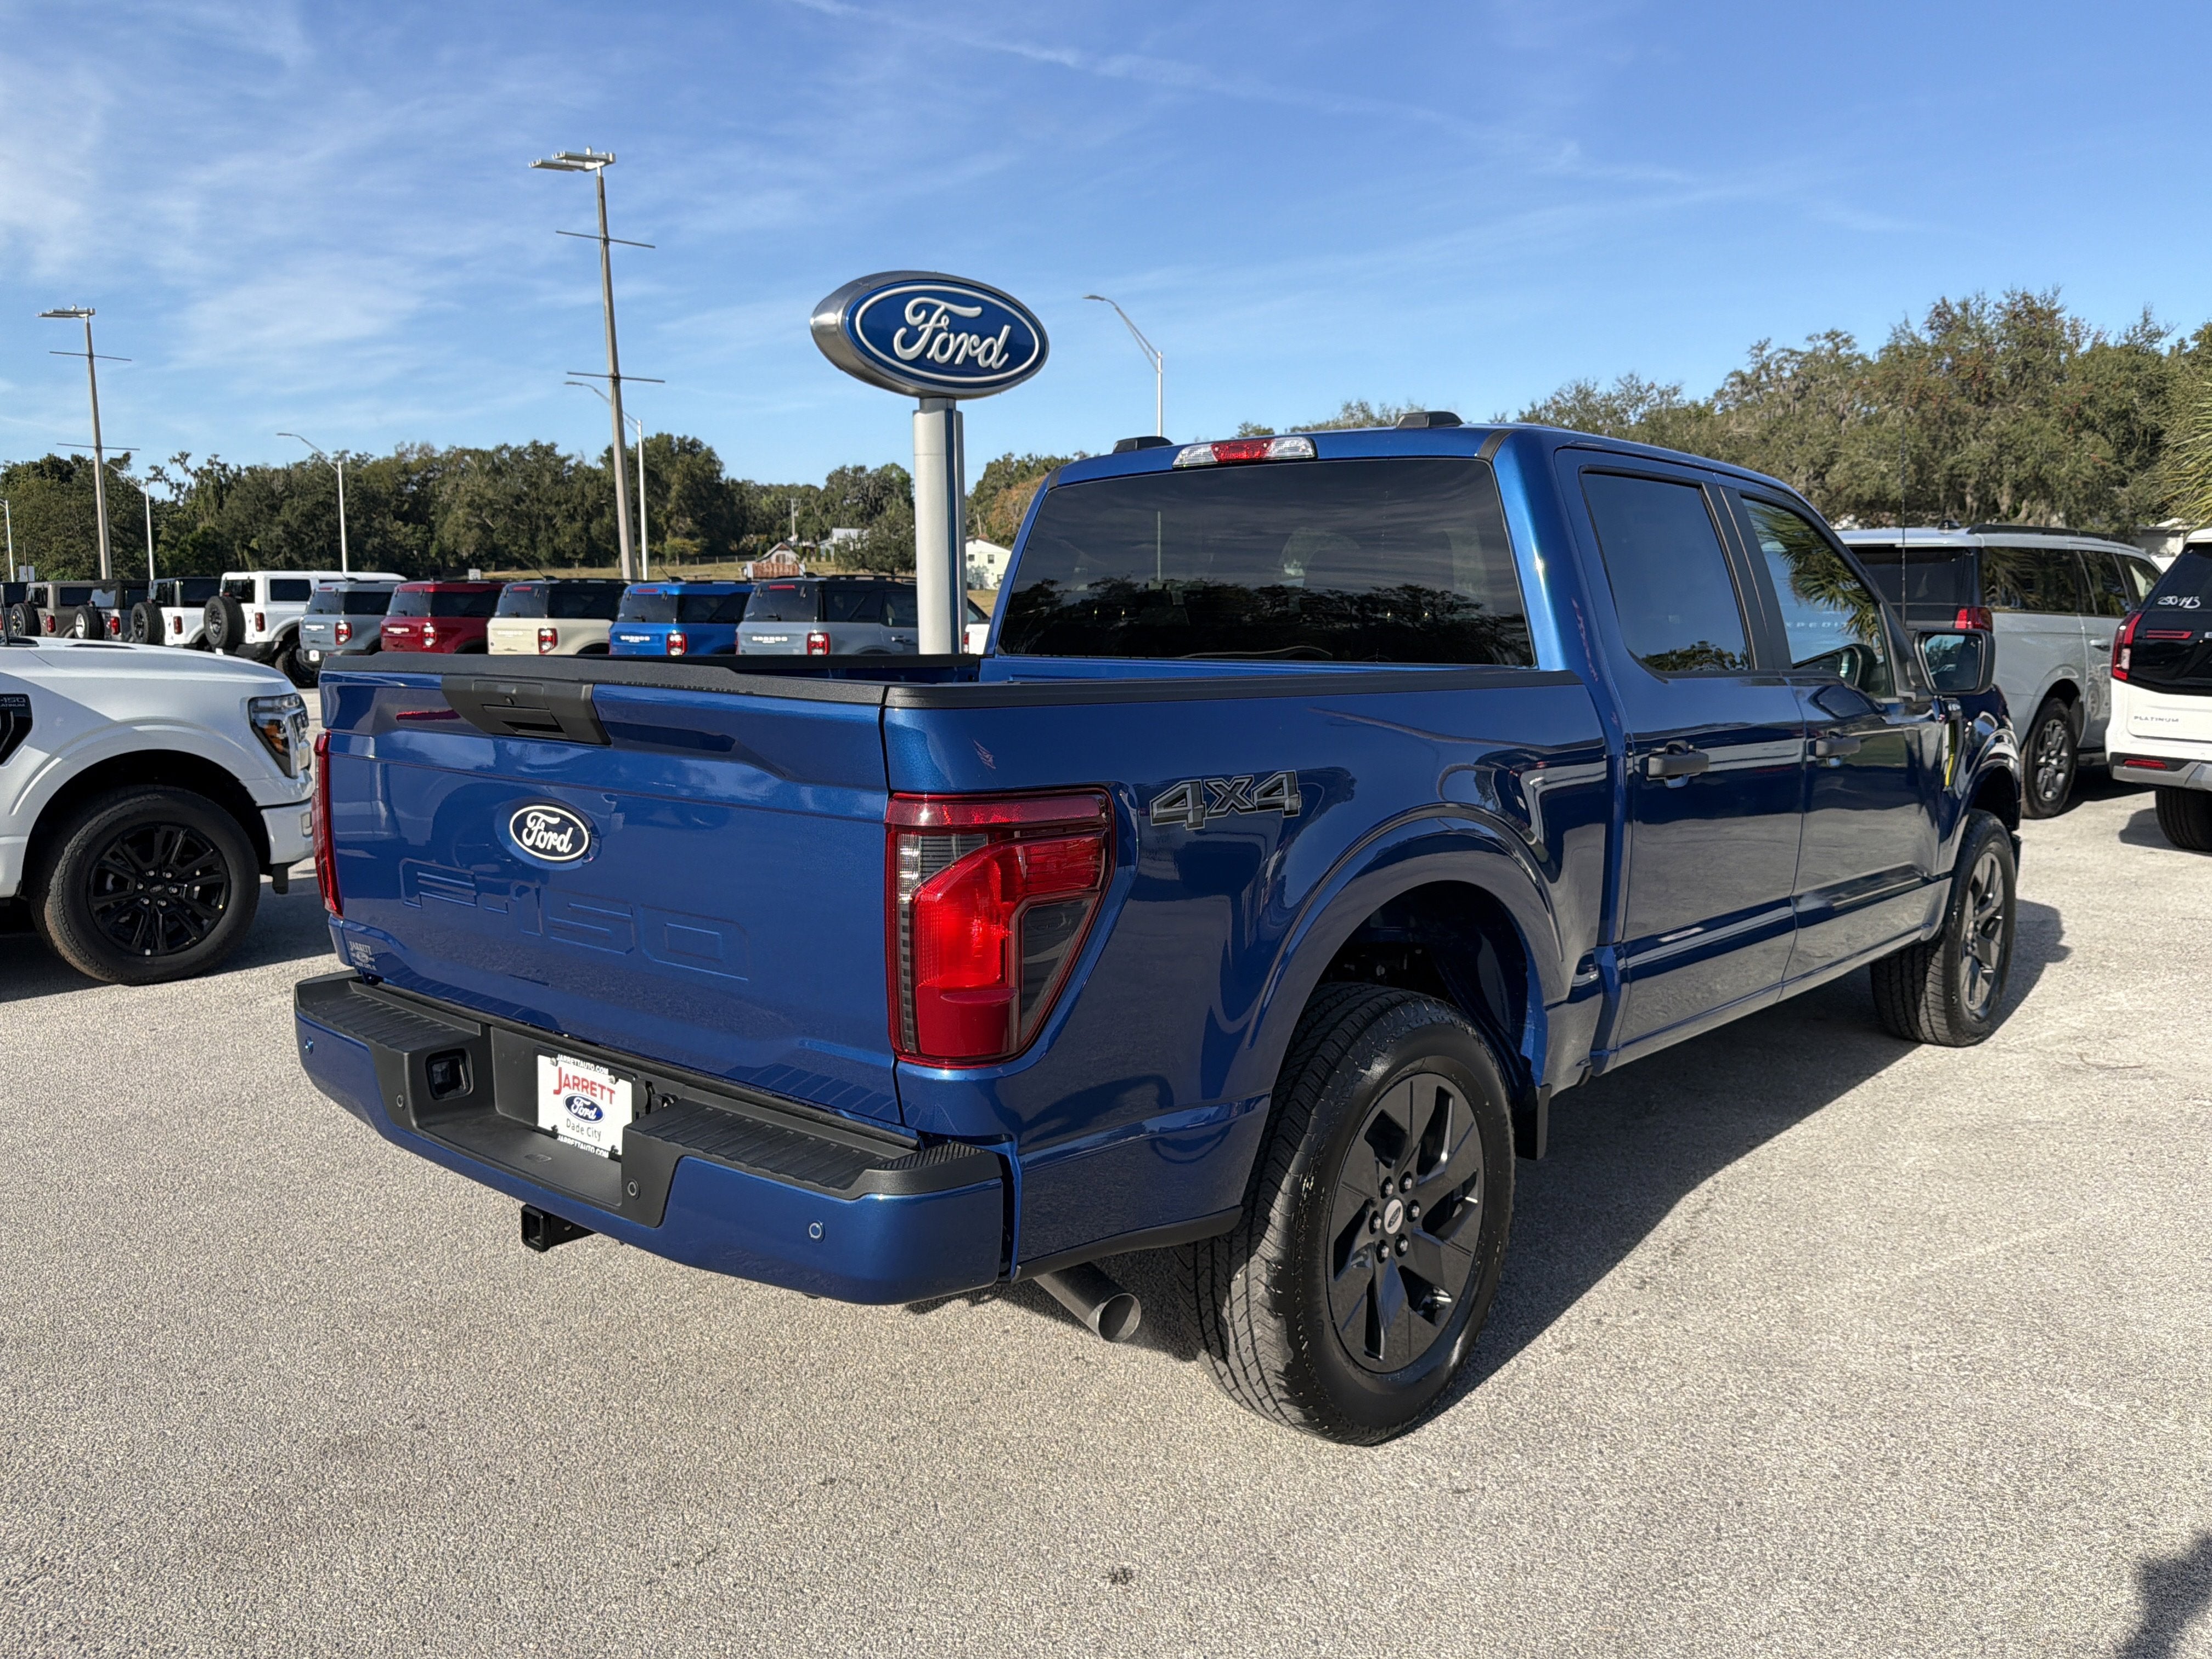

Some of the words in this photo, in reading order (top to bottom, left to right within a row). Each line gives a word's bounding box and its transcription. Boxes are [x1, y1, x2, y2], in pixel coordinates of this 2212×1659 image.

[893, 297, 1011, 370] Ford
[522, 811, 573, 853] Ford
[399, 857, 749, 981] F-150
[553, 1066, 616, 1105] JARRETT
[571, 1097, 597, 1120] Ford
[566, 1118, 584, 1135] Dade
[586, 1127, 602, 1142] City
